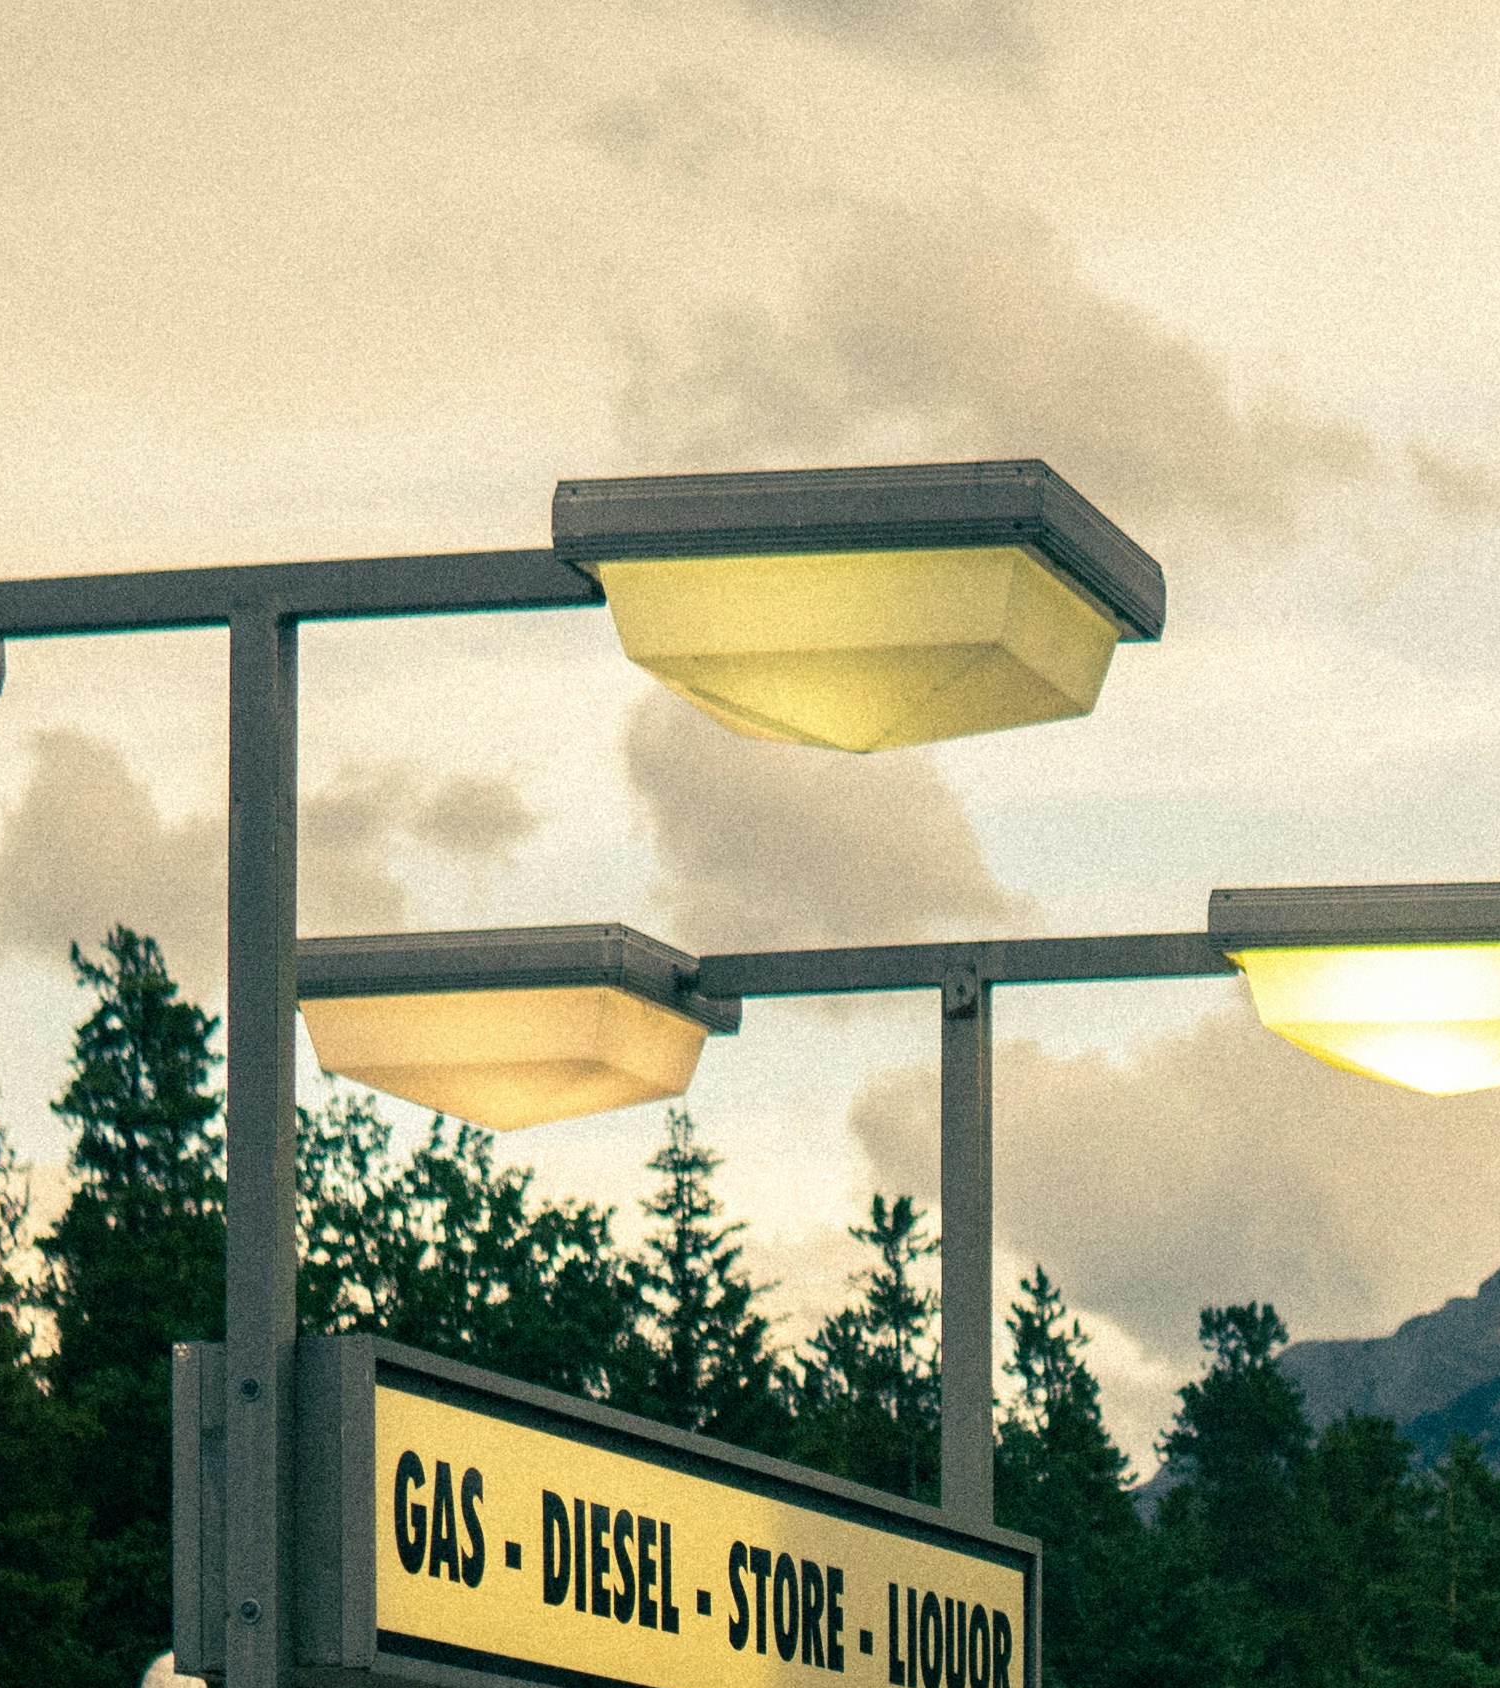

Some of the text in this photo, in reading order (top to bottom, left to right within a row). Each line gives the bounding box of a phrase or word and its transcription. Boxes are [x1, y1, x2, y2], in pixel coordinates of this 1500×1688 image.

[394, 1450, 486, 1589] GAS
[542, 1490, 681, 1634] DIESEL
[728, 1540, 846, 1674] STORE
